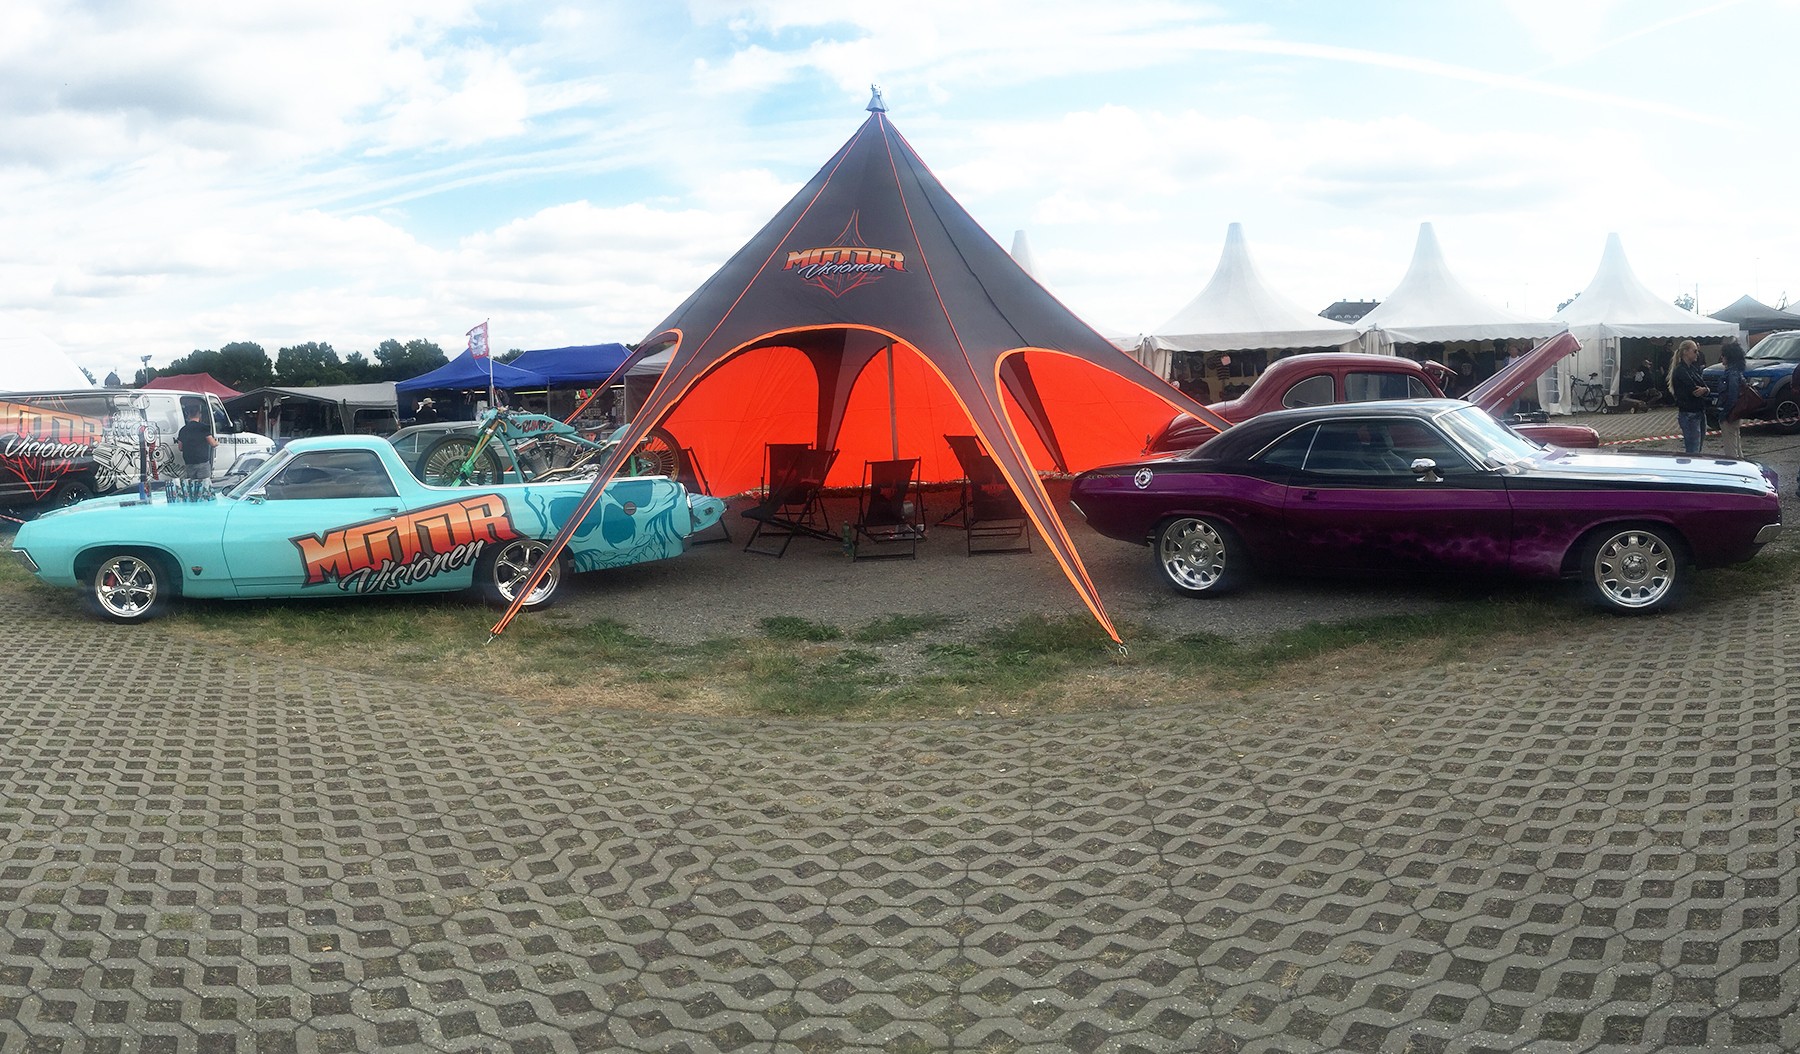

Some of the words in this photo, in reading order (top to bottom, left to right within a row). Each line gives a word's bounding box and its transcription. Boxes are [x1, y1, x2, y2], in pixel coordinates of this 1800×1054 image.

[783, 246, 905, 272] MOTOR
[798, 261, 886, 279] Visionen
[0, 401, 103, 447] OTOR
[1, 432, 89, 458] Visionen
[292, 494, 527, 584] MOTOR
[338, 540, 486, 593] Visionen
